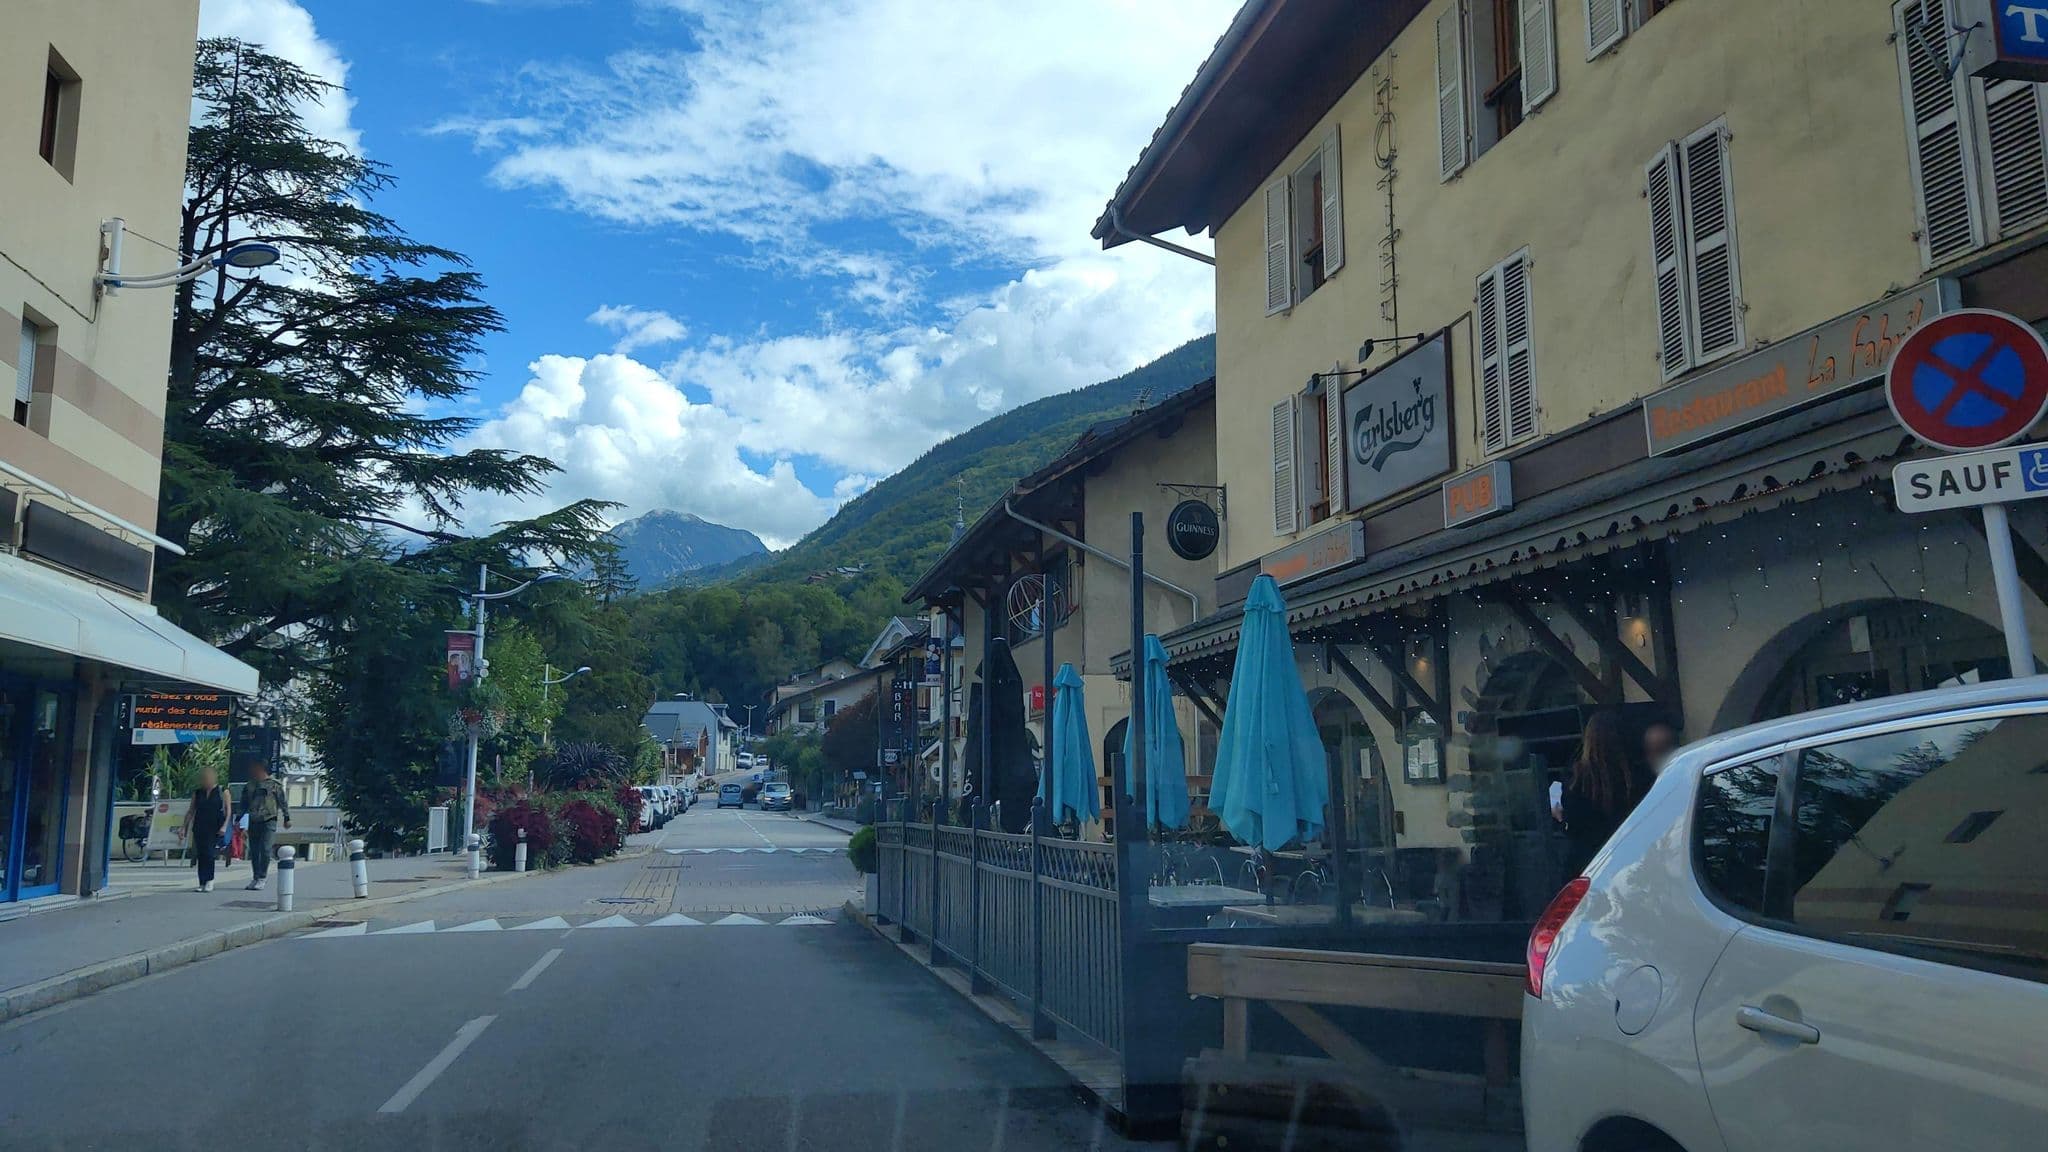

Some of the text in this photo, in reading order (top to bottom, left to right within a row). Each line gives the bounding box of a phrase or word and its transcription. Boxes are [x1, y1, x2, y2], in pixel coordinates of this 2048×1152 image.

[1651, 362, 1788, 439] Restaurant
[1807, 334, 1838, 390] La
[1353, 393, 1435, 466] Carlsberg
[1448, 474, 1493, 520] PUB
[1910, 460, 2012, 500] SAUF
[1176, 521, 1216, 537] GUINNESS
[189, 708, 229, 716] disques
[893, 692, 902, 722] BAR
